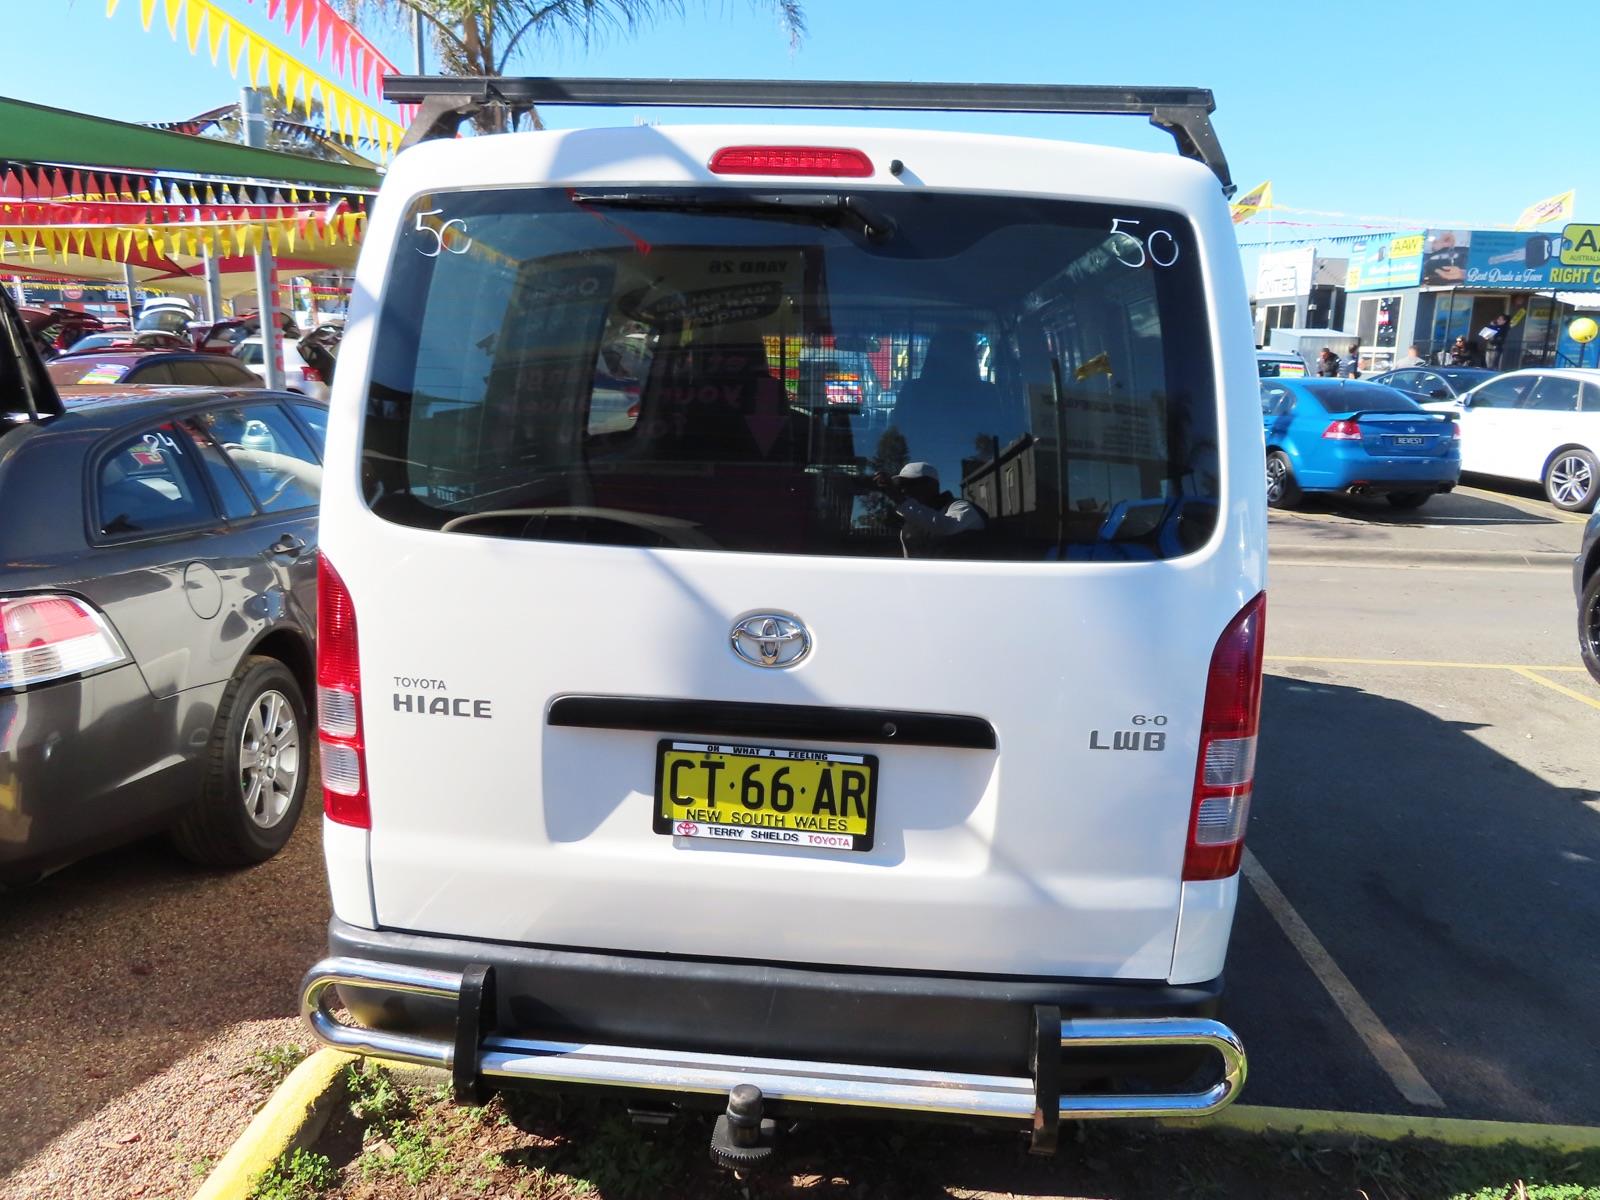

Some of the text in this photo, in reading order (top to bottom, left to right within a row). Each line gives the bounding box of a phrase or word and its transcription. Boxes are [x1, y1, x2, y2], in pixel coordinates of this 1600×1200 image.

[1110, 218, 1179, 268] 50
[1549, 267, 1591, 283] RIGHT
[143, 432, 183, 457] 24
[393, 676, 447, 690] TOYOTA
[393, 693, 492, 719] HIACE
[1089, 730, 1166, 752] LWB
[707, 744, 720, 753] OH
[733, 746, 760, 757] WHAT
[788, 751, 828, 762] FEELING
[686, 808, 848, 832] NEW SOUTH WALES
[708, 826, 851, 847] TERRY SHIELDS TOYOTA
